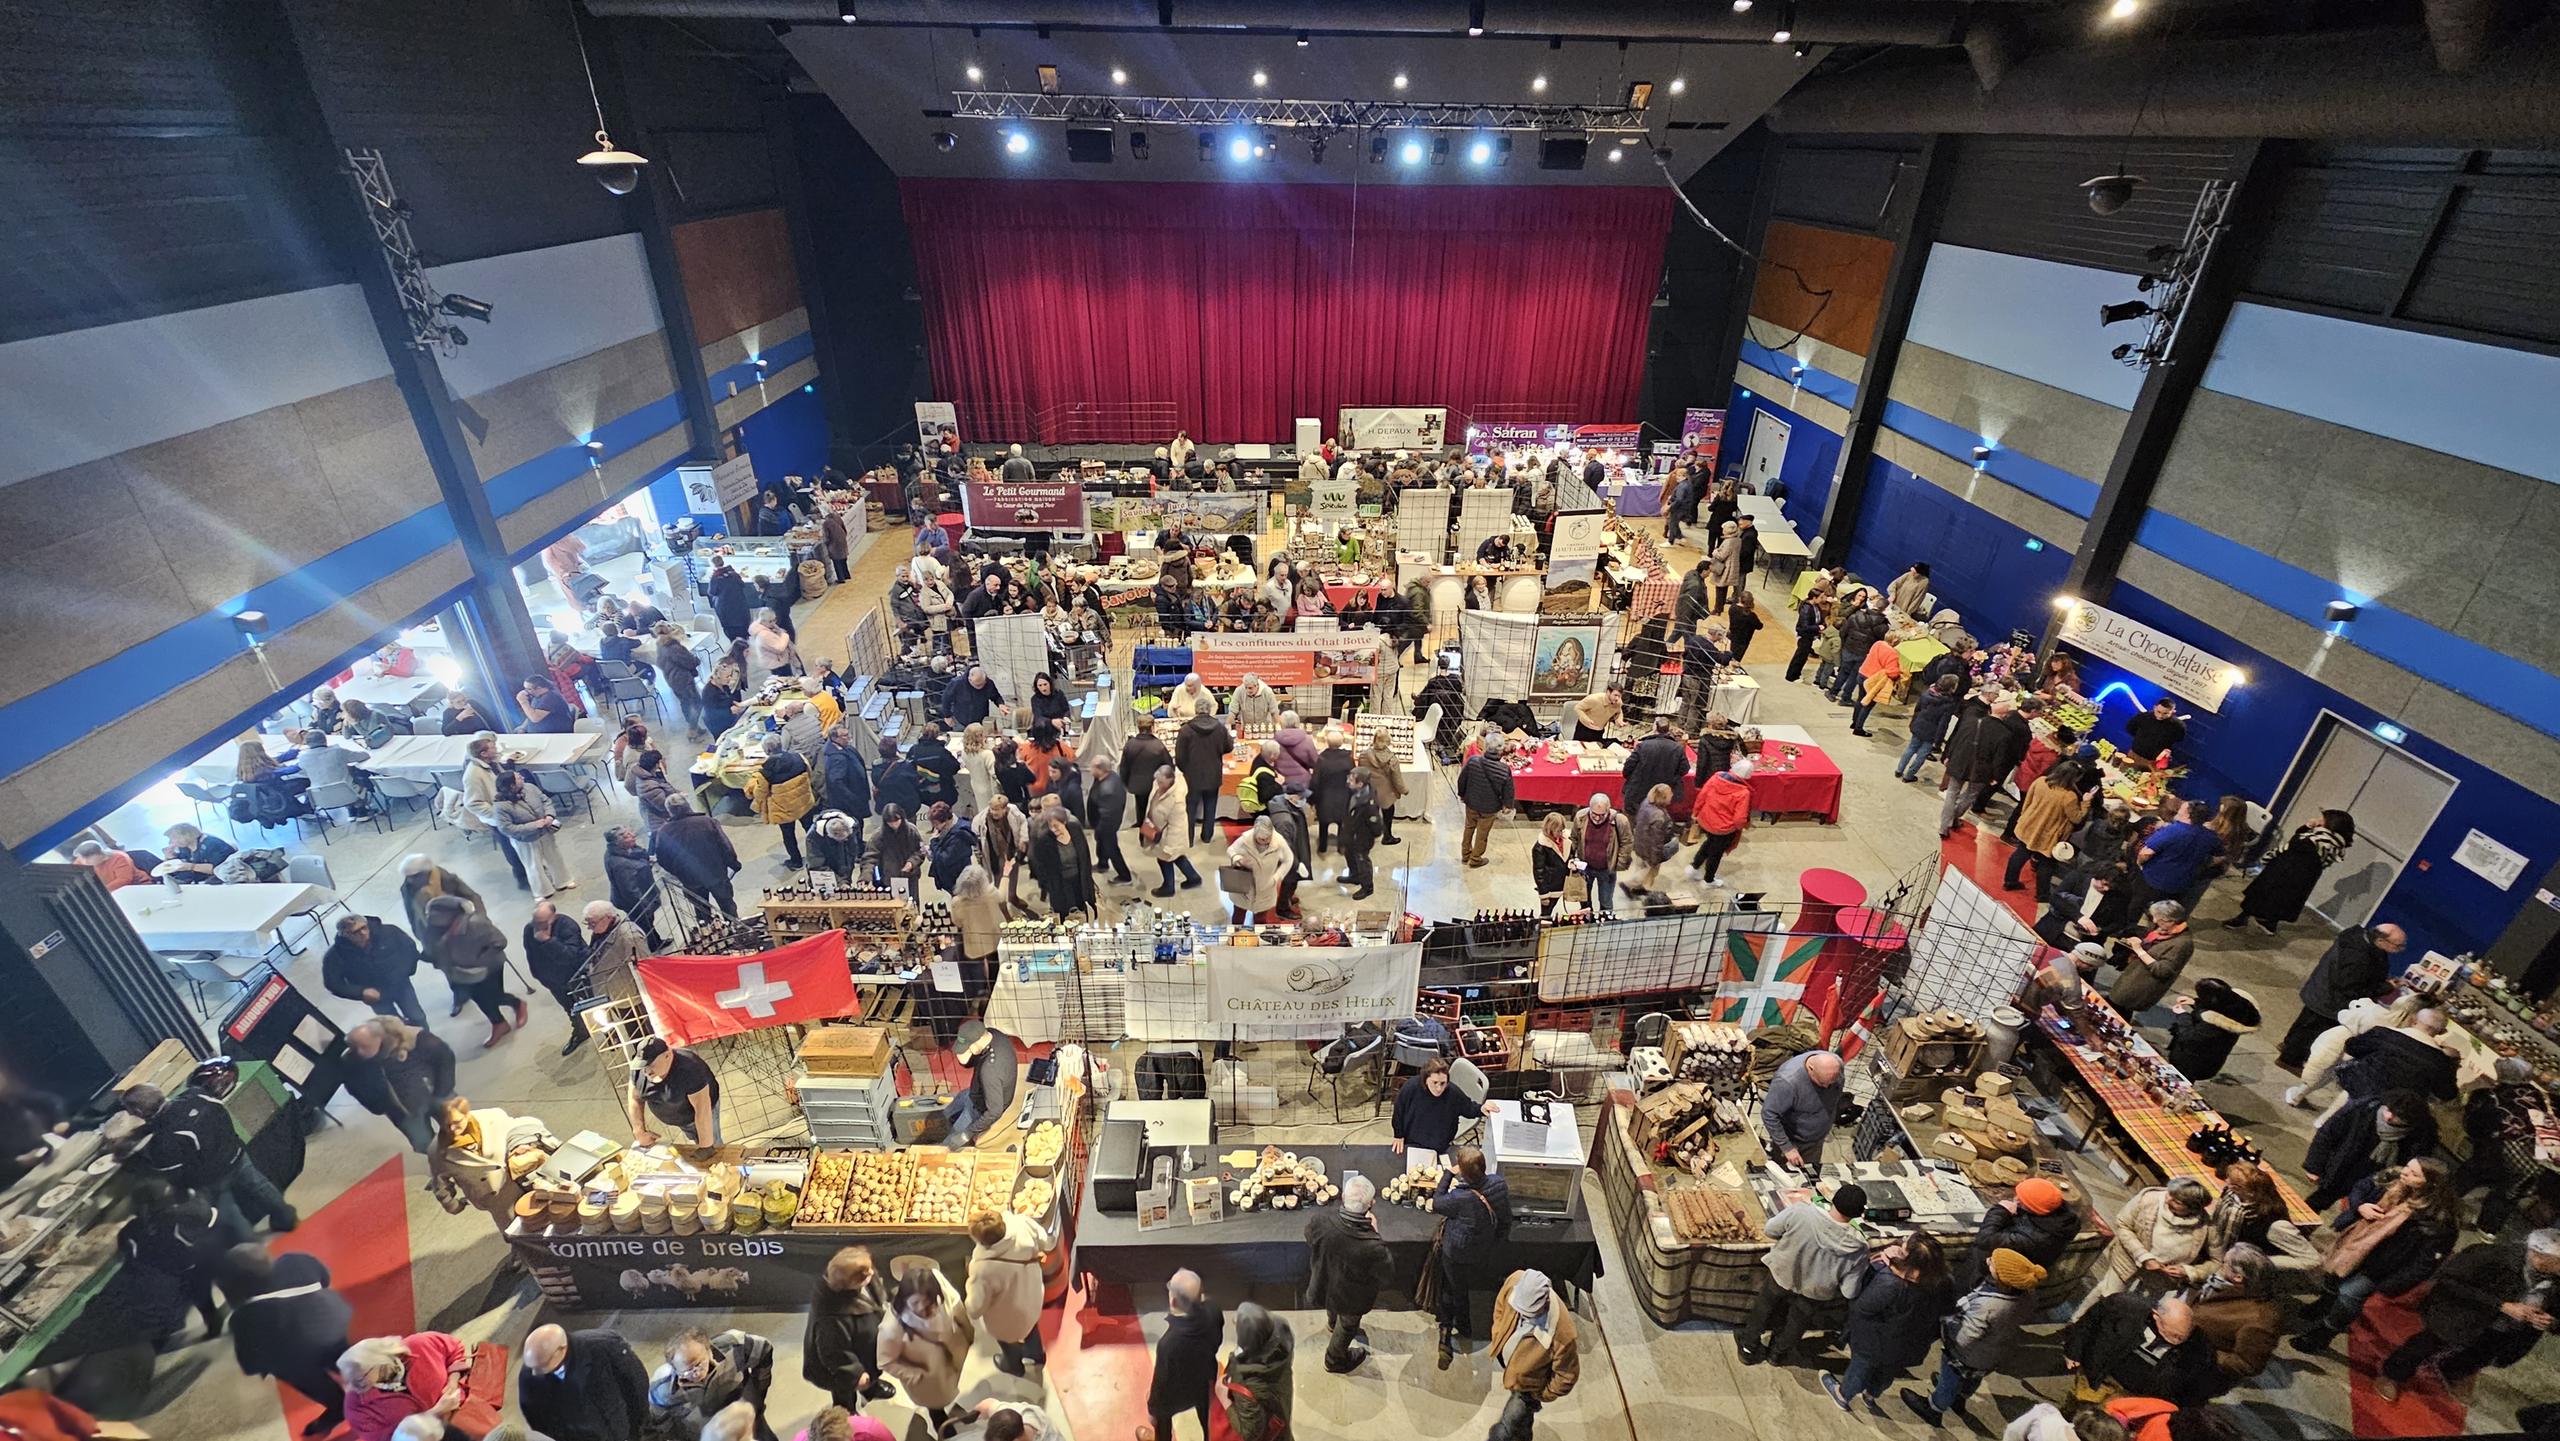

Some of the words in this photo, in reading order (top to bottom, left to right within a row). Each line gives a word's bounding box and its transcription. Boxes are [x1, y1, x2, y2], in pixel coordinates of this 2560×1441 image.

[1493, 426, 1537, 439] Safran
[983, 486, 995, 496] Le
[996, 486, 1017, 496] Petit
[1018, 486, 1065, 496] Gourmand
[1122, 506, 1151, 518] Savoie
[1100, 587, 1150, 609] Savoie
[1213, 638, 1233, 648] Les
[1235, 637, 1294, 648] confitures
[1297, 637, 1311, 647] du
[1313, 636, 1340, 647] Chat
[2104, 618, 2125, 637] La
[2128, 630, 2223, 684] Chocolataise
[2107, 639, 2130, 655] Artisan
[2130, 650, 2167, 671] chocolatier
[2167, 667, 2189, 682] depuis
[235, 982, 282, 1034] AUJOURD'HUI
[1227, 997, 1304, 1011] CHÂTEAU
[1310, 999, 1339, 1011] DES
[1346, 996, 1396, 1008] HELIX
[548, 1239, 644, 1258] tomme
[652, 1239, 685, 1256] de
[700, 1237, 784, 1257] brebis
